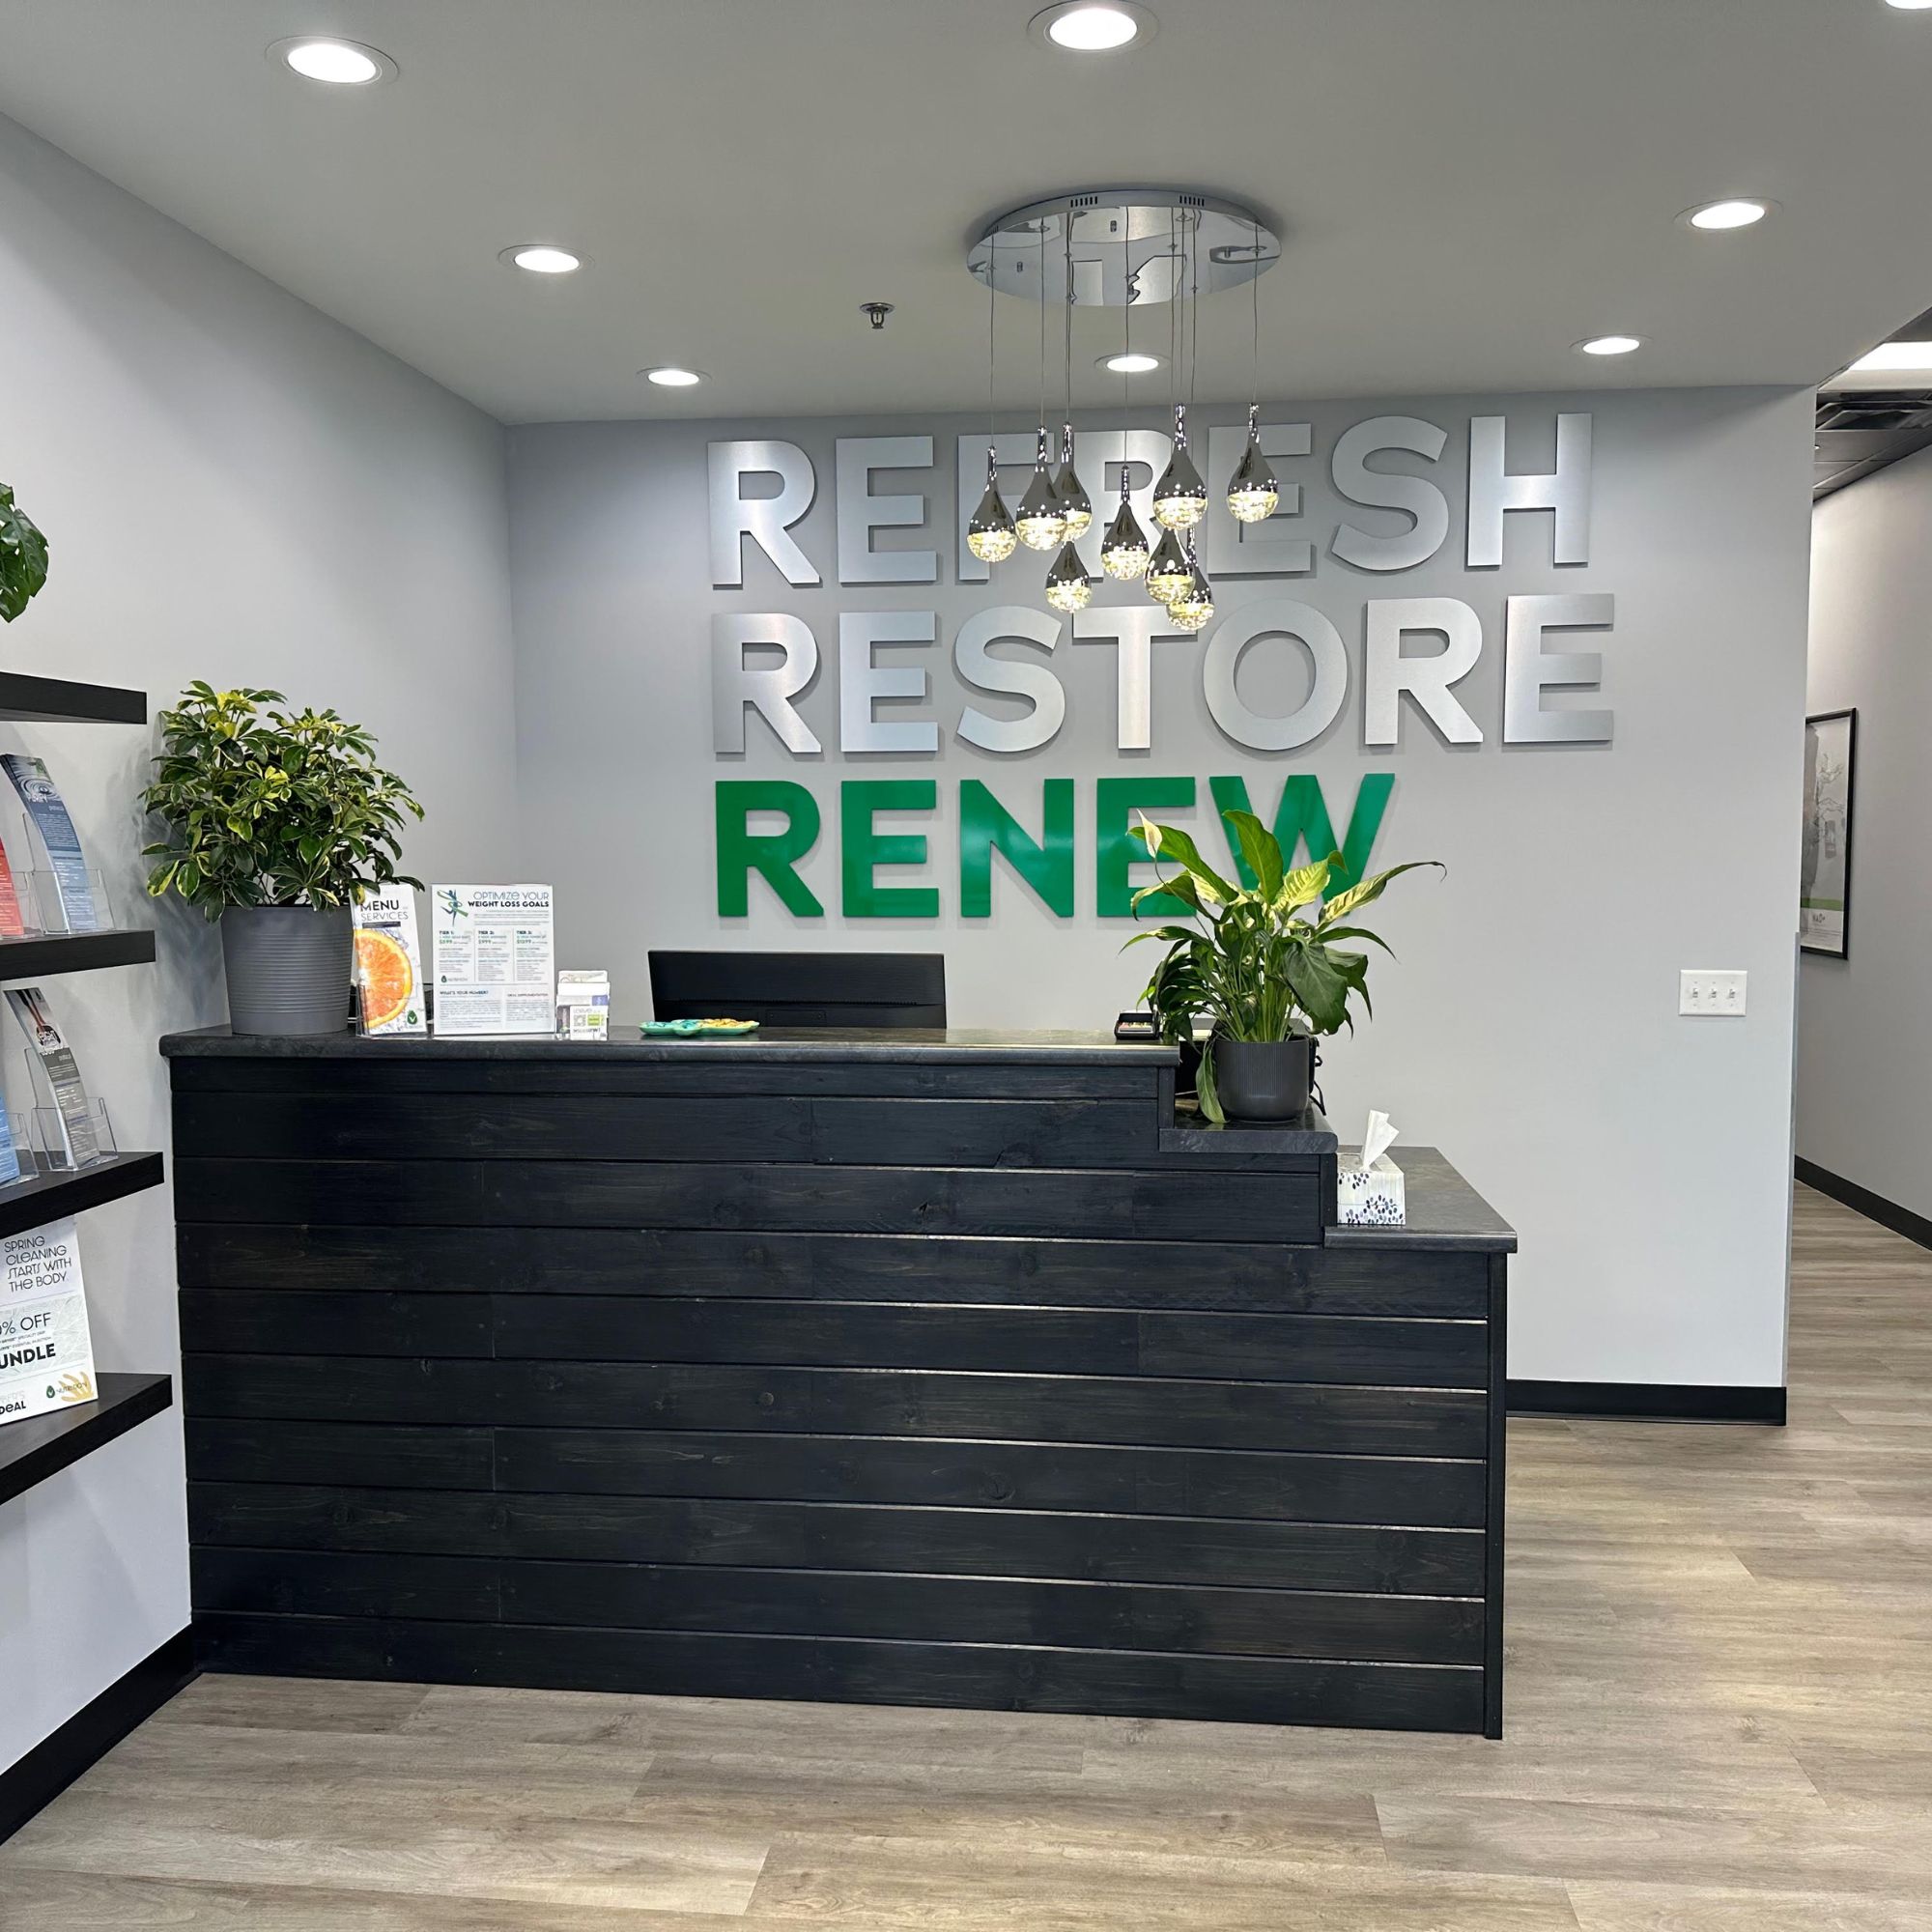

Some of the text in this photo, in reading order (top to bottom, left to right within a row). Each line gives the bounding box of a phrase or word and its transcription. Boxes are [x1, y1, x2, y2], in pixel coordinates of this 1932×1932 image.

[707, 412, 1593, 586] REFRESH
[711, 593, 1614, 754] RESTORE
[716, 773, 1396, 918] RENEW
[522, 891, 549, 900] YOUR
[360, 899, 399, 912] MENU
[361, 911, 409, 922] SERVICES
[4, 1236, 45, 1253] SPRING
[8, 1257, 72, 1280] STARTS WITH
[20, 1312, 52, 1331] OFF
